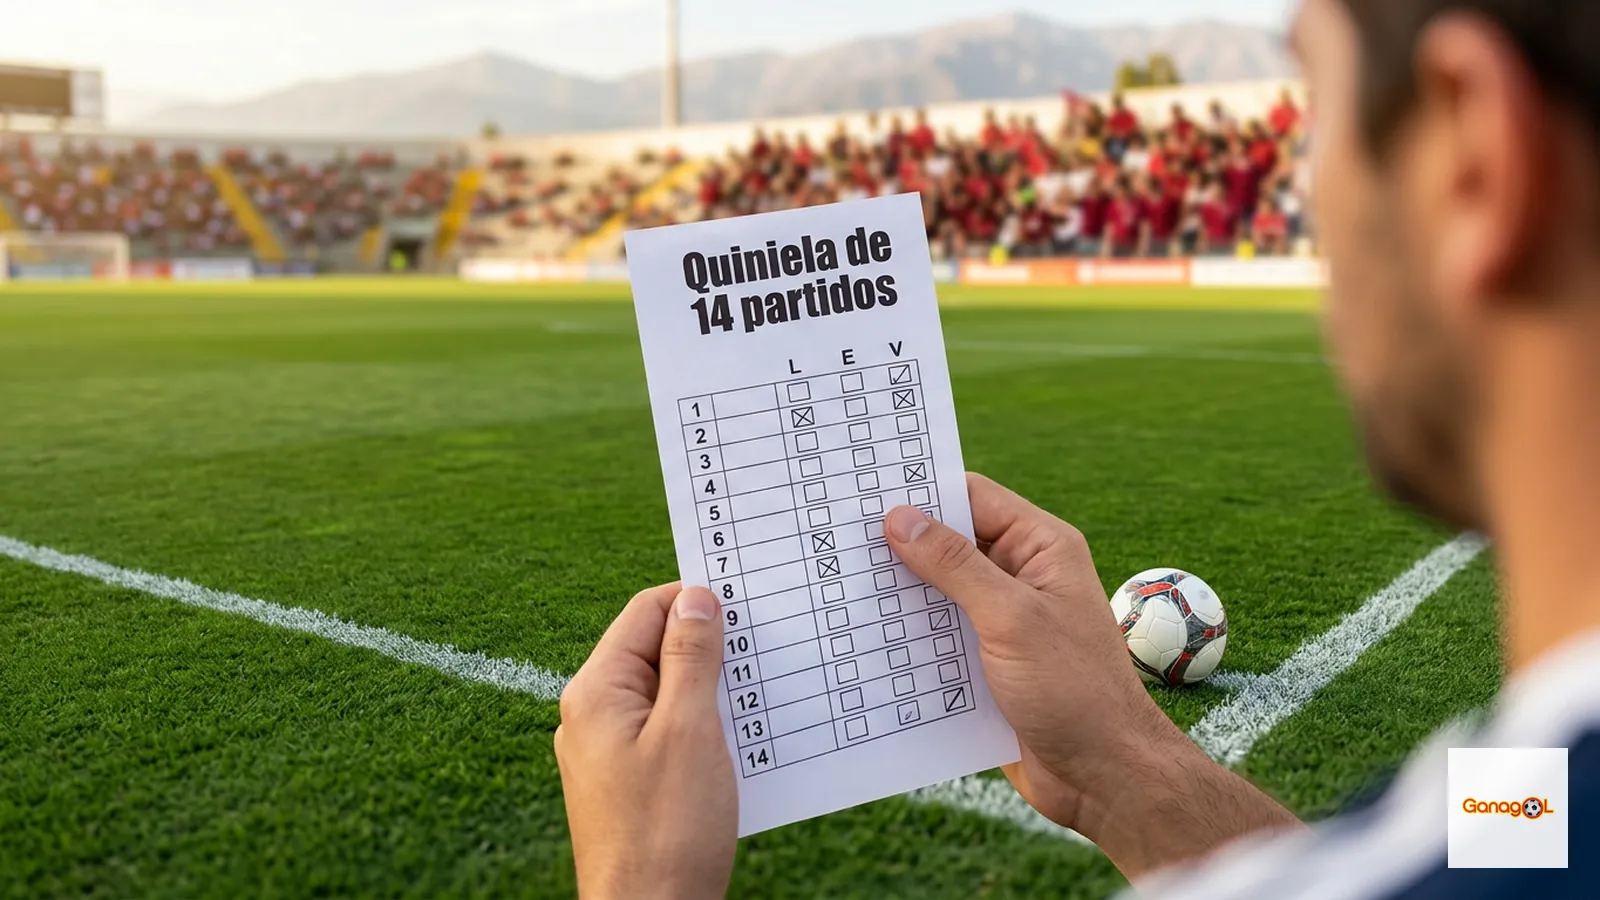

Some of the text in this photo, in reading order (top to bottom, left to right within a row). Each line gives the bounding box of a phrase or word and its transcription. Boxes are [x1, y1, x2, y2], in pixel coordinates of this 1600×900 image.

[682, 226, 892, 295] Quiniela de
[690, 273, 898, 336] 14 partidos
[788, 340, 903, 375] L E V
[691, 402, 701, 418] 1
[695, 428, 707, 445] 2
[699, 453, 711, 470] 3
[704, 479, 717, 495] 4
[709, 504, 721, 521] 5
[713, 531, 725, 547] 6
[716, 556, 728, 573] 7
[722, 583, 734, 600] 8
[726, 609, 738, 627] 9
[726, 635, 749, 655] 10
[732, 663, 752, 683] 11
[736, 691, 760, 711] 12
[741, 720, 764, 740] 13
[746, 748, 770, 769] 14
